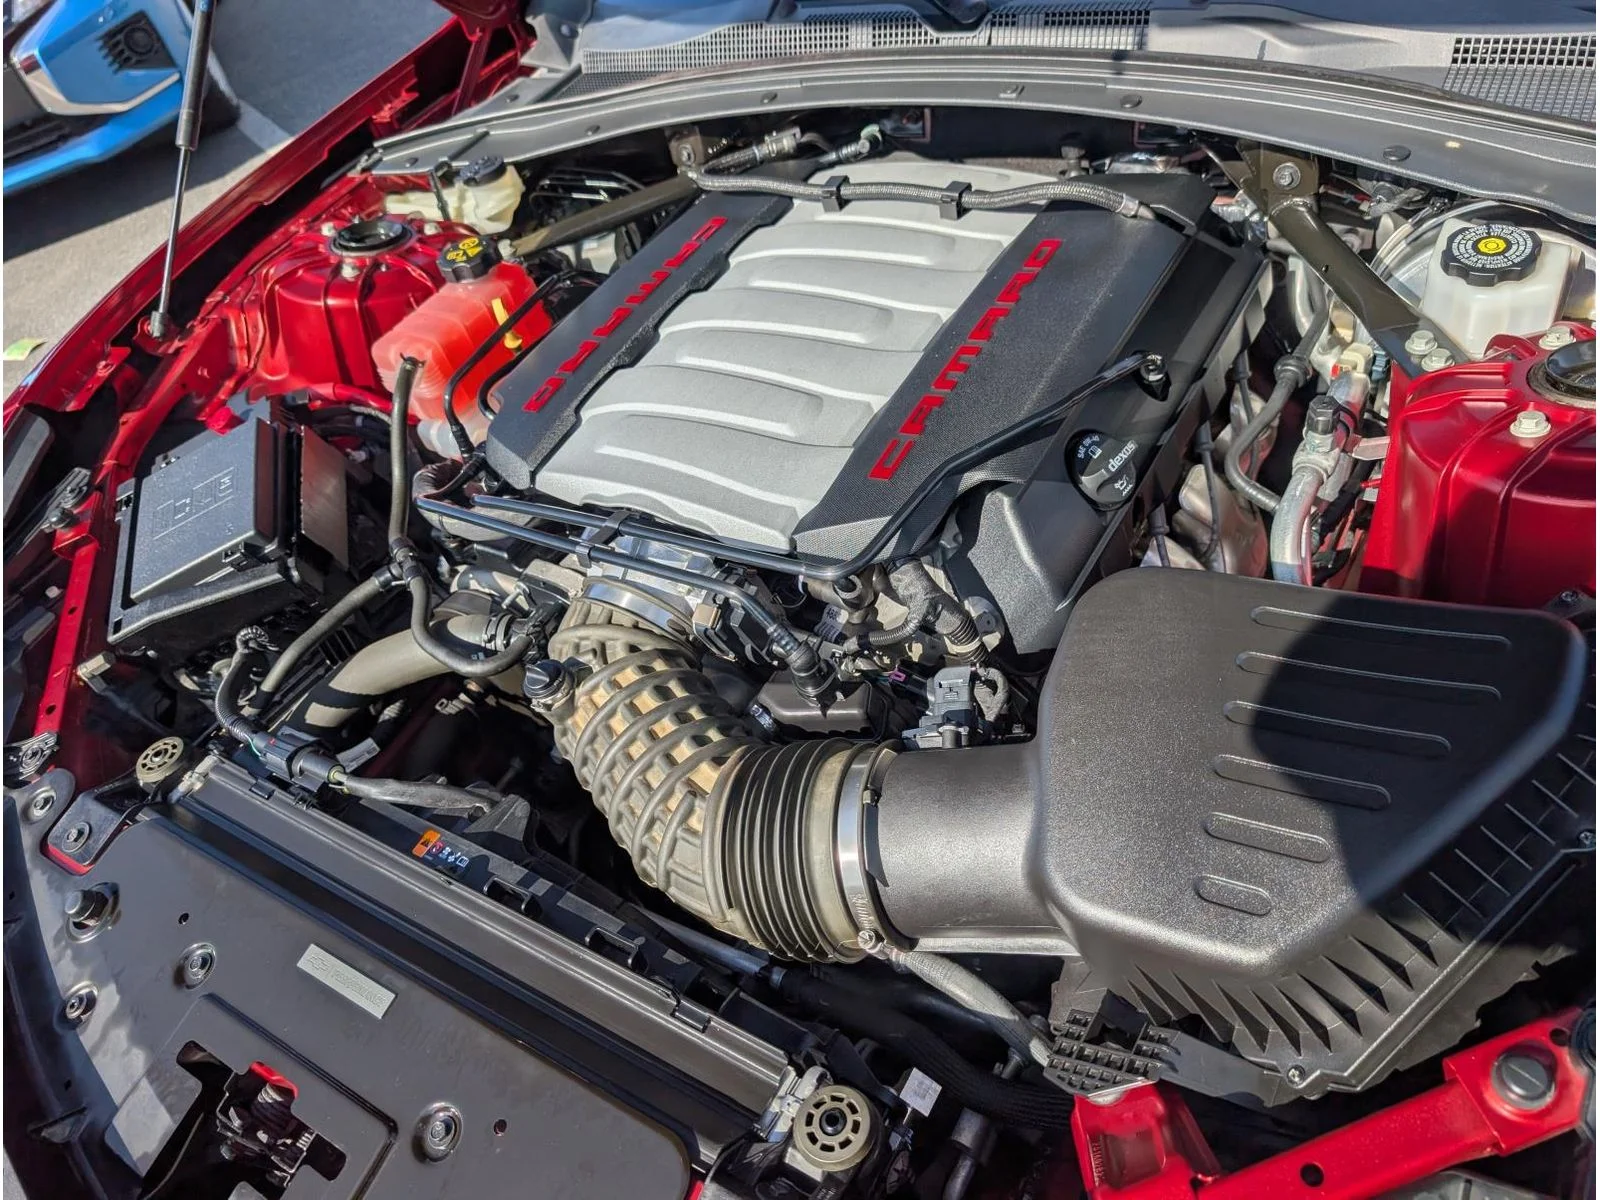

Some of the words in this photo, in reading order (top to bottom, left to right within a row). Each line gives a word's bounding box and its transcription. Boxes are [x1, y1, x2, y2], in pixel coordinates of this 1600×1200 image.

[522, 215, 728, 413] CAMARO
[867, 238, 1064, 481] CAMARO
[1108, 439, 1138, 472] dexos
